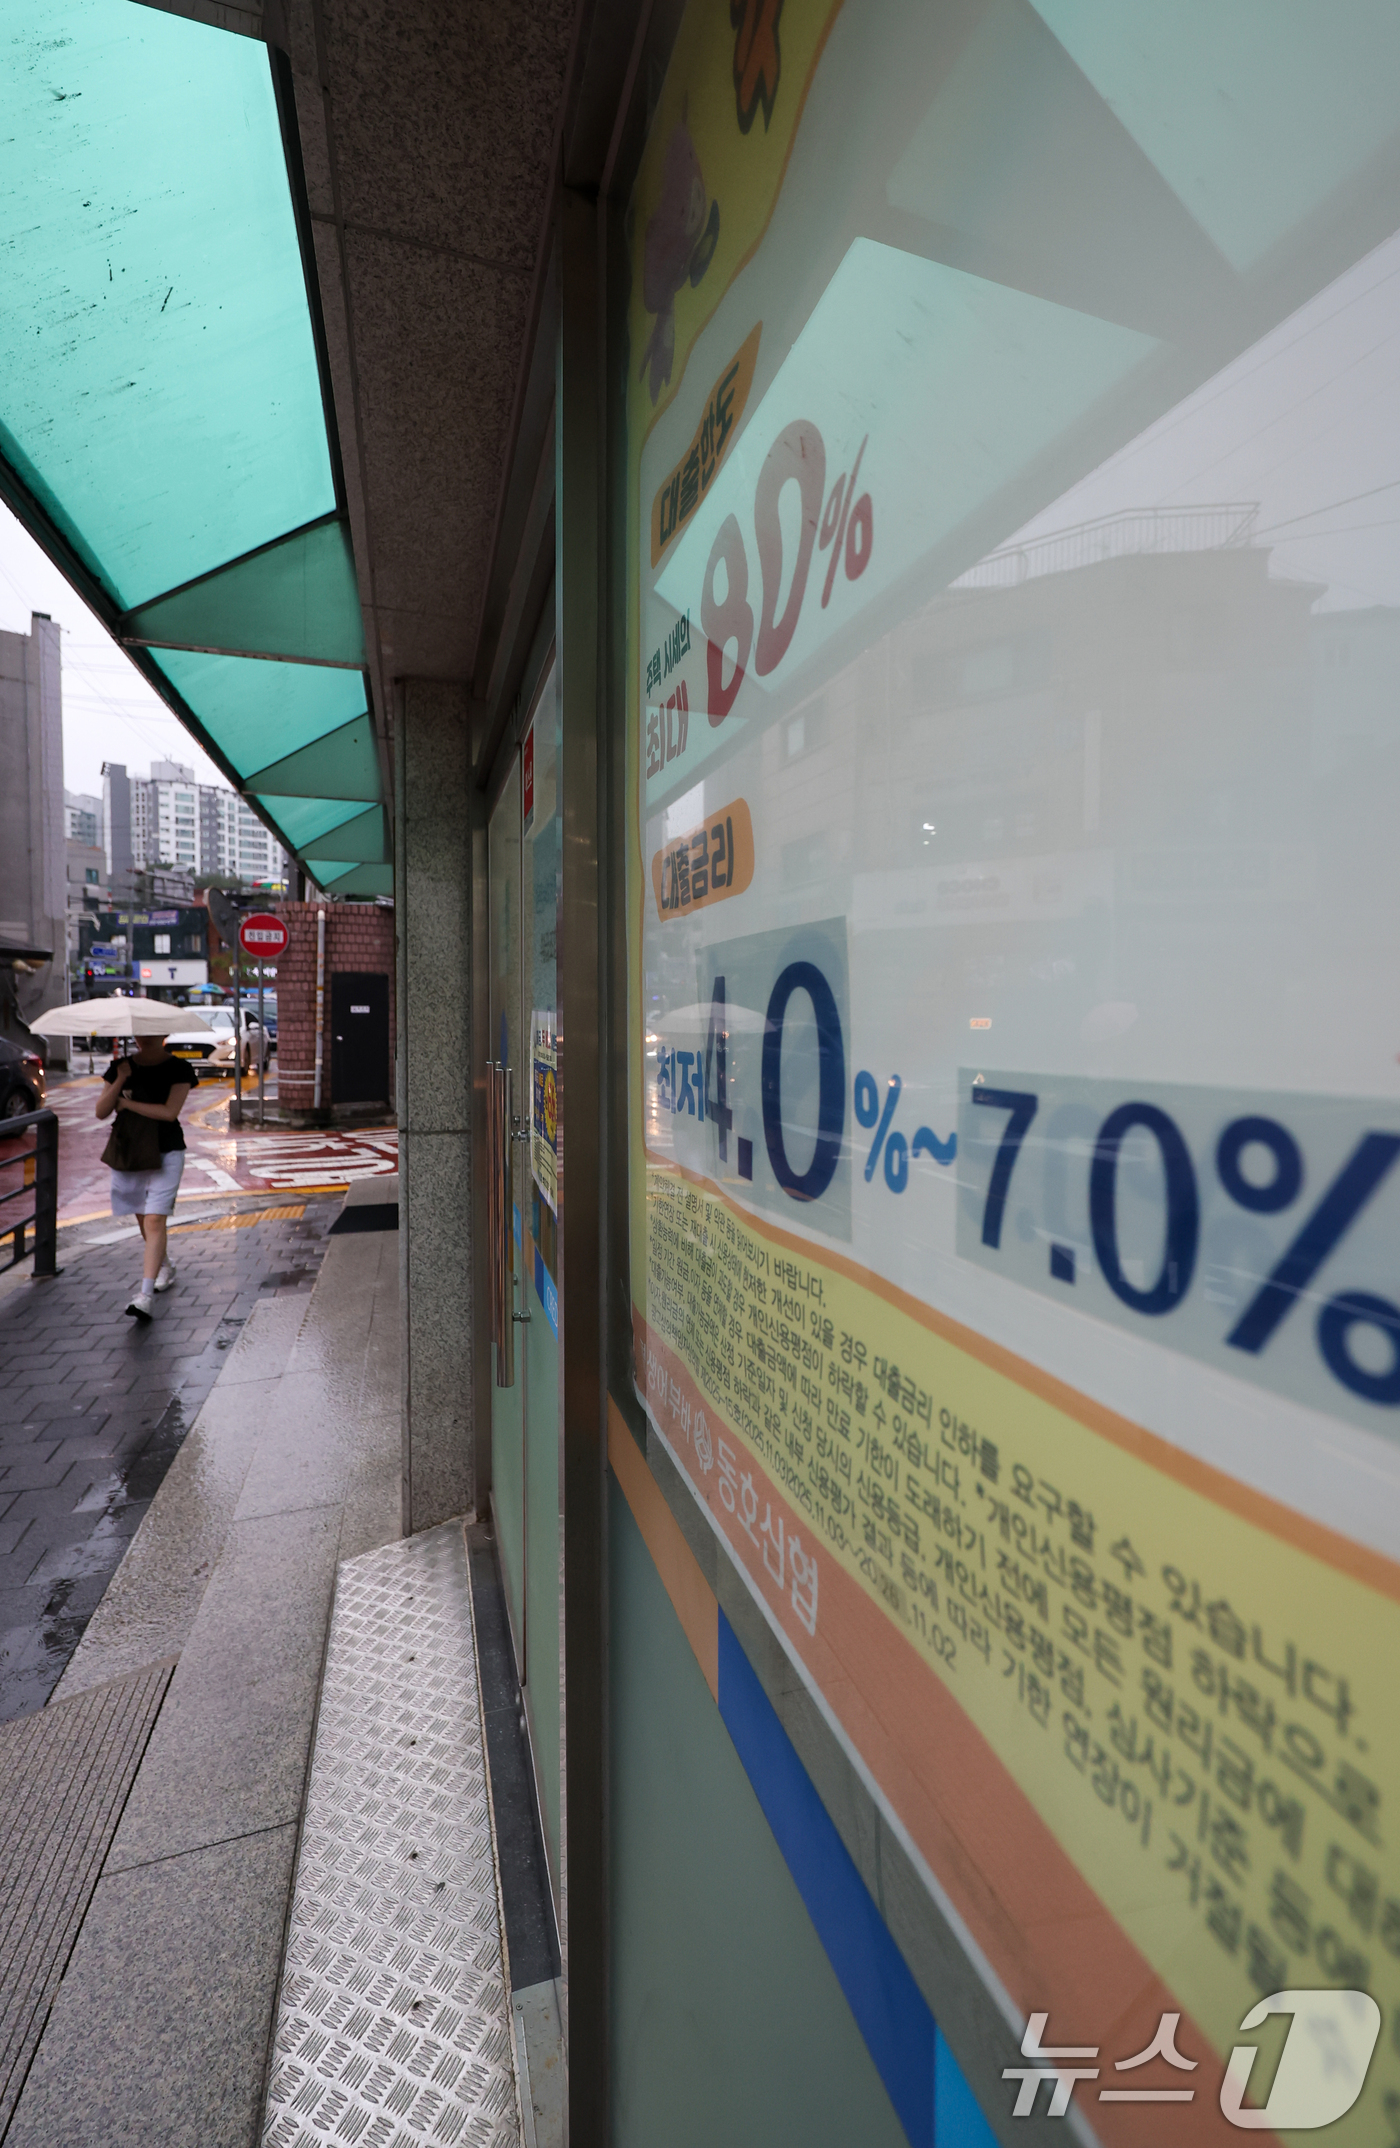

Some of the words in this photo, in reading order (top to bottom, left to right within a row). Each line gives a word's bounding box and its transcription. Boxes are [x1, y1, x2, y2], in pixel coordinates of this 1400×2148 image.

[659, 361, 740, 547] 대출한도
[646, 679, 689, 780] 최대
[701, 418, 873, 728] 80%
[646, 649, 662, 698] 주택
[664, 608, 691, 680] 시세의
[661, 816, 734, 910] 대출금리
[657, 1045, 705, 1122] 최저
[774, 1257, 826, 1308] 바랍니다.
[729, 1313, 744, 1344] 경우
[801, 1375, 823, 1416] 따라
[827, 1398, 852, 1442] 만료
[855, 1427, 899, 1492] 기한이
[733, 1285, 745, 1317] 경우
[828, 1361, 869, 1418] 하락할
[872, 1400, 887, 1431] 수
[733, 1375, 761, 1419] 하락과
[764, 1403, 782, 1443] 같은
[784, 1428, 804, 1466] 내부
[807, 1455, 857, 1530] 신용평가
[772, 1288, 806, 1330] 개선이
[810, 1311, 835, 1351] 있을
[840, 1331, 868, 1371] 경우
[872, 1356, 933, 1430] 대출금리
[939, 1407, 1001, 1486] 인하를
[1012, 1463, 1096, 1555] 요구할
[1109, 1536, 1147, 1582] 수
[779, 1388, 789, 1417] 및
[792, 1402, 812, 1443] 신청
[816, 1425, 852, 1487] 당시의
[716, 1436, 820, 1637] 동호신협
